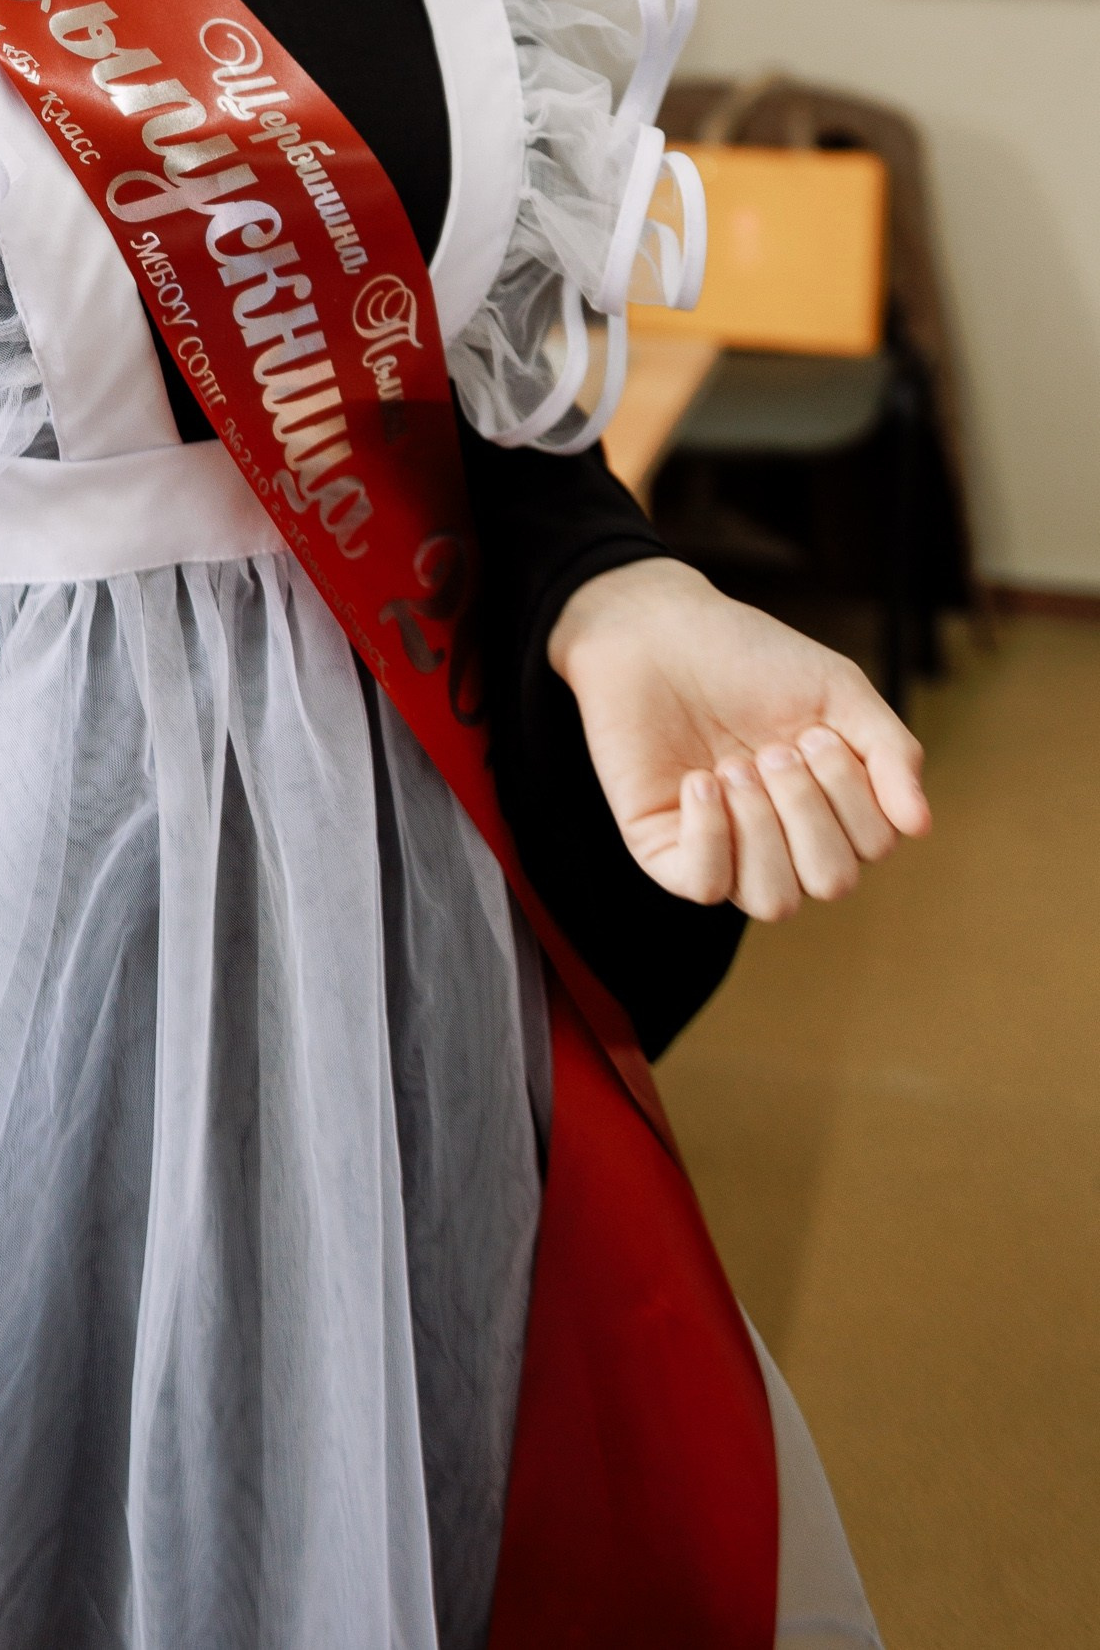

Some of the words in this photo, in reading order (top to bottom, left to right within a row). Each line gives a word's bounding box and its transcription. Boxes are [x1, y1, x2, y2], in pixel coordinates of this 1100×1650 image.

[39, 90, 101, 165] Класс
[199, 17, 369, 275] Щербинина
[130, 231, 198, 328] МБОУ
[177, 336, 227, 411] СОШ
